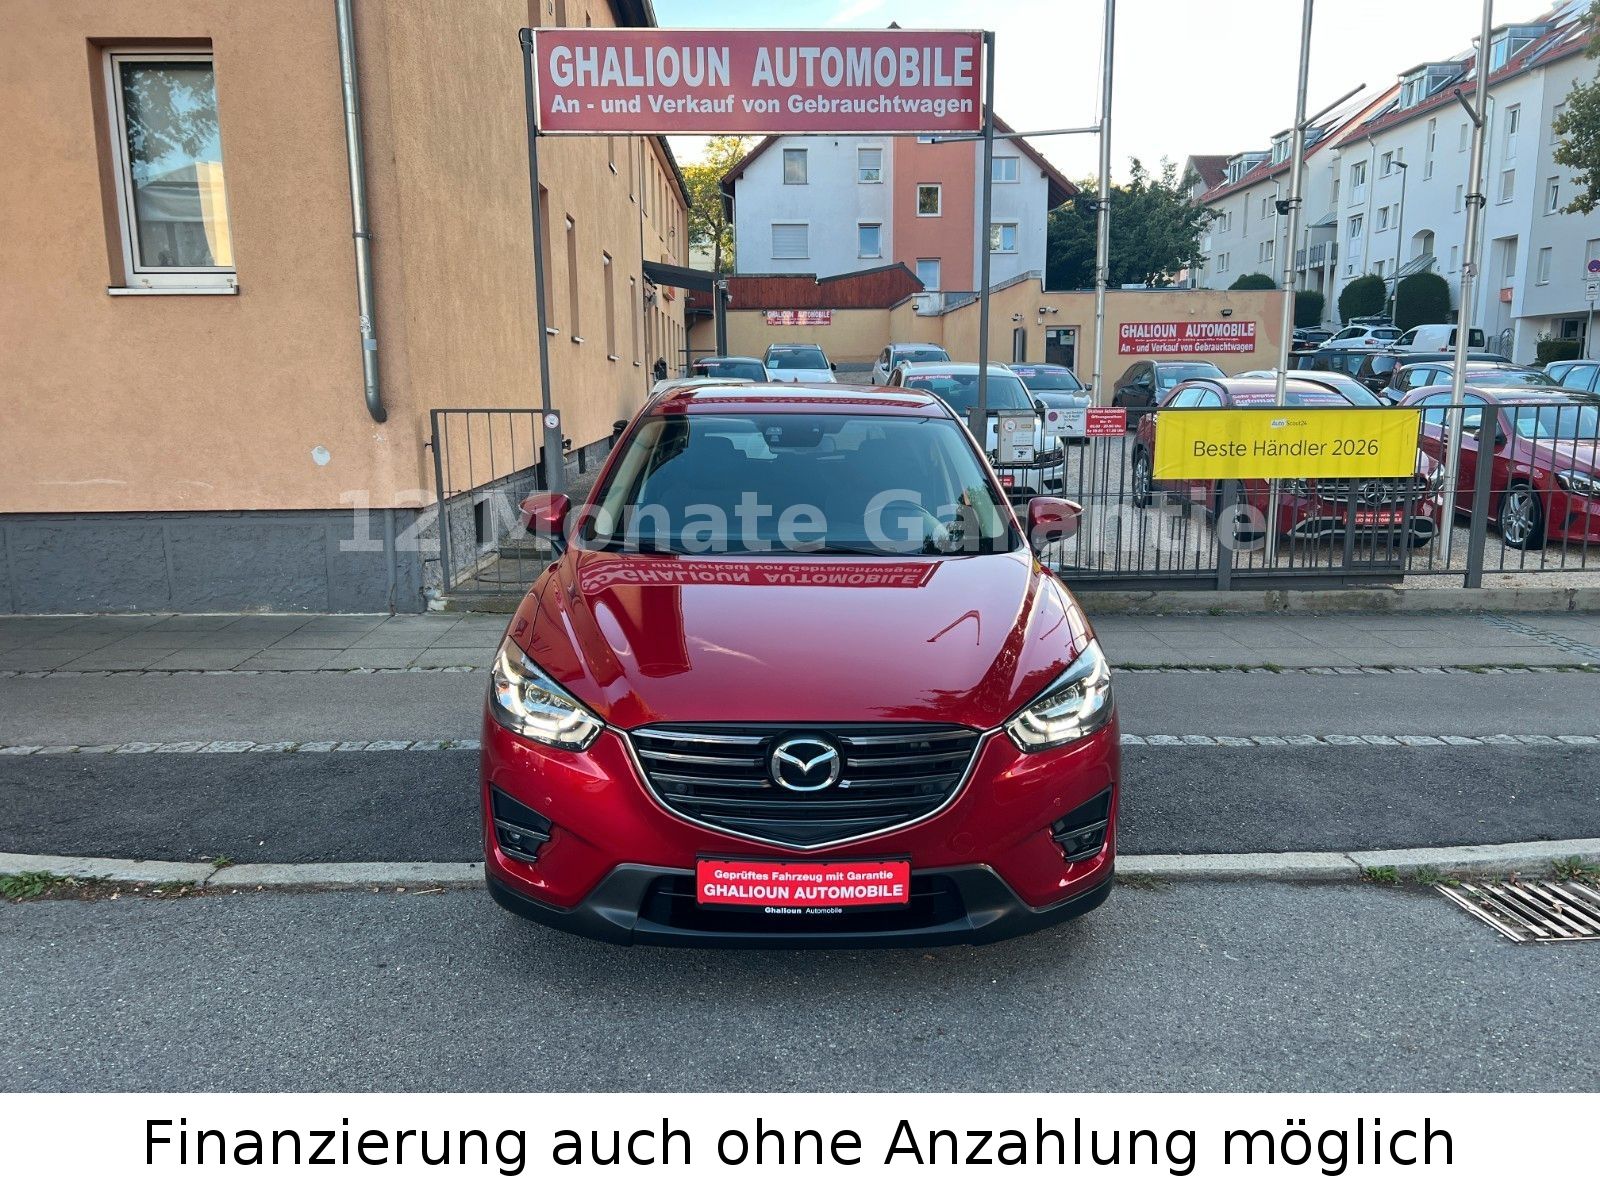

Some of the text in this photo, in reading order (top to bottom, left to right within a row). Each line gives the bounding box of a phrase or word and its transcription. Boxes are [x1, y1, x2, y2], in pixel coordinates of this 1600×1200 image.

[549, 45, 973, 88] GHALIOUN AUTOMOBILE
[551, 95, 580, 113] An
[601, 94, 641, 113] und
[648, 94, 735, 113] Verkauf
[742, 99, 780, 113] von
[787, 94, 973, 118] Gebrauchtwagen
[1121, 323, 1255, 338] GHALIOUN AUTOMOBILE
[1121, 343, 1130, 352] An
[1136, 343, 1149, 352] und
[1152, 343, 1179, 352] Verkauf
[1181, 344, 1193, 352] von
[1195, 342, 1253, 353] Gebrauchtwagen
[1194, 438, 1379, 457] Beste Händler 2026
[714, 869, 893, 882] Geprüftes Fahrzeug mit Garantie
[704, 884, 903, 899] GHALIOUN AUTOMOBILE
[765, 906, 802, 914] Ghalioun
